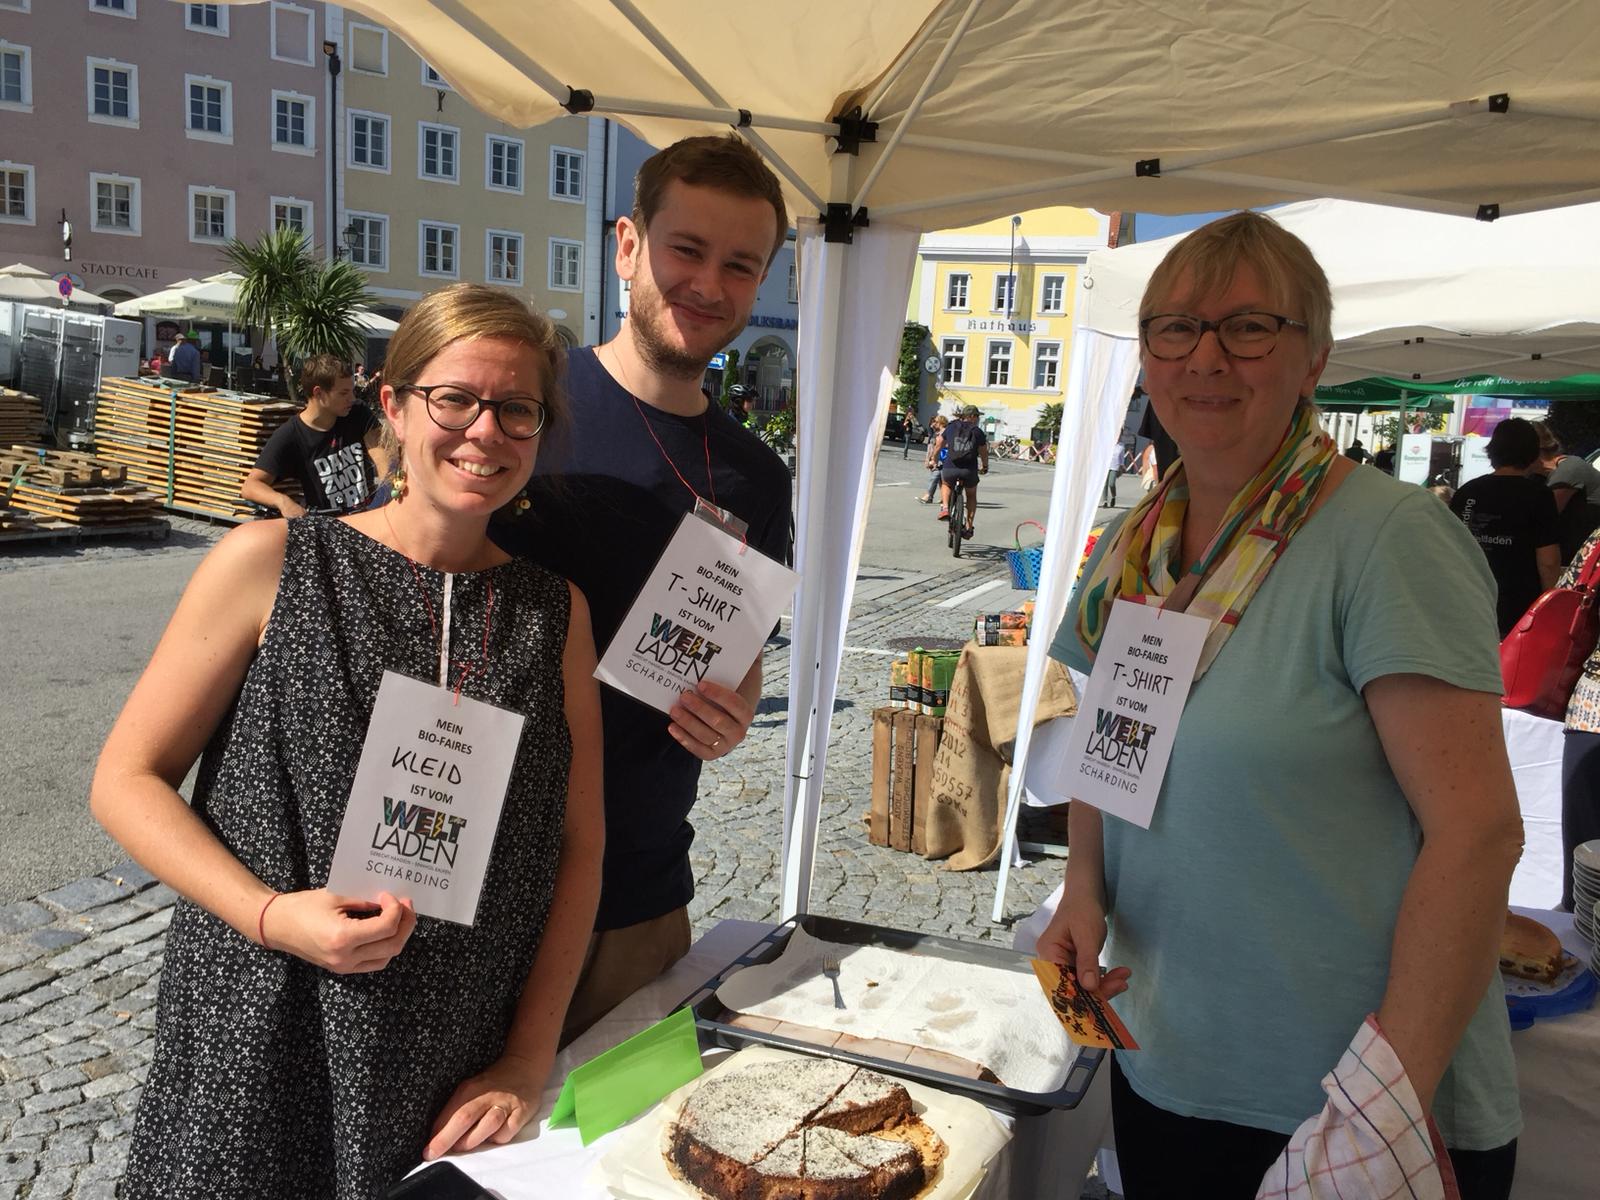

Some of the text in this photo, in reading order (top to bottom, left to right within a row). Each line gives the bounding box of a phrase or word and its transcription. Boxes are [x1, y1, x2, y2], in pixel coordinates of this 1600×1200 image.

[967, 318, 1037, 332] Rathaus
[696, 566, 744, 597] BIO-FAIRES
[715, 560, 739, 578] MEIN
[678, 608, 716, 633] IST VOM
[650, 612, 723, 666] WELT
[1142, 634, 1163, 647] MEIN
[635, 632, 710, 683] LADEN
[1127, 646, 1169, 665] BIO-FAIRES
[1116, 695, 1148, 714] IST VOM
[436, 718, 464, 735] MEIN
[1096, 707, 1157, 751] WELT
[418, 729, 473, 755] BIO-FAIRES
[1085, 731, 1149, 775] LADEN
[391, 746, 462, 785] KLEID
[410, 783, 453, 805] IST VOM
[383, 796, 467, 844] WELT
[371, 822, 459, 869] LADEN
